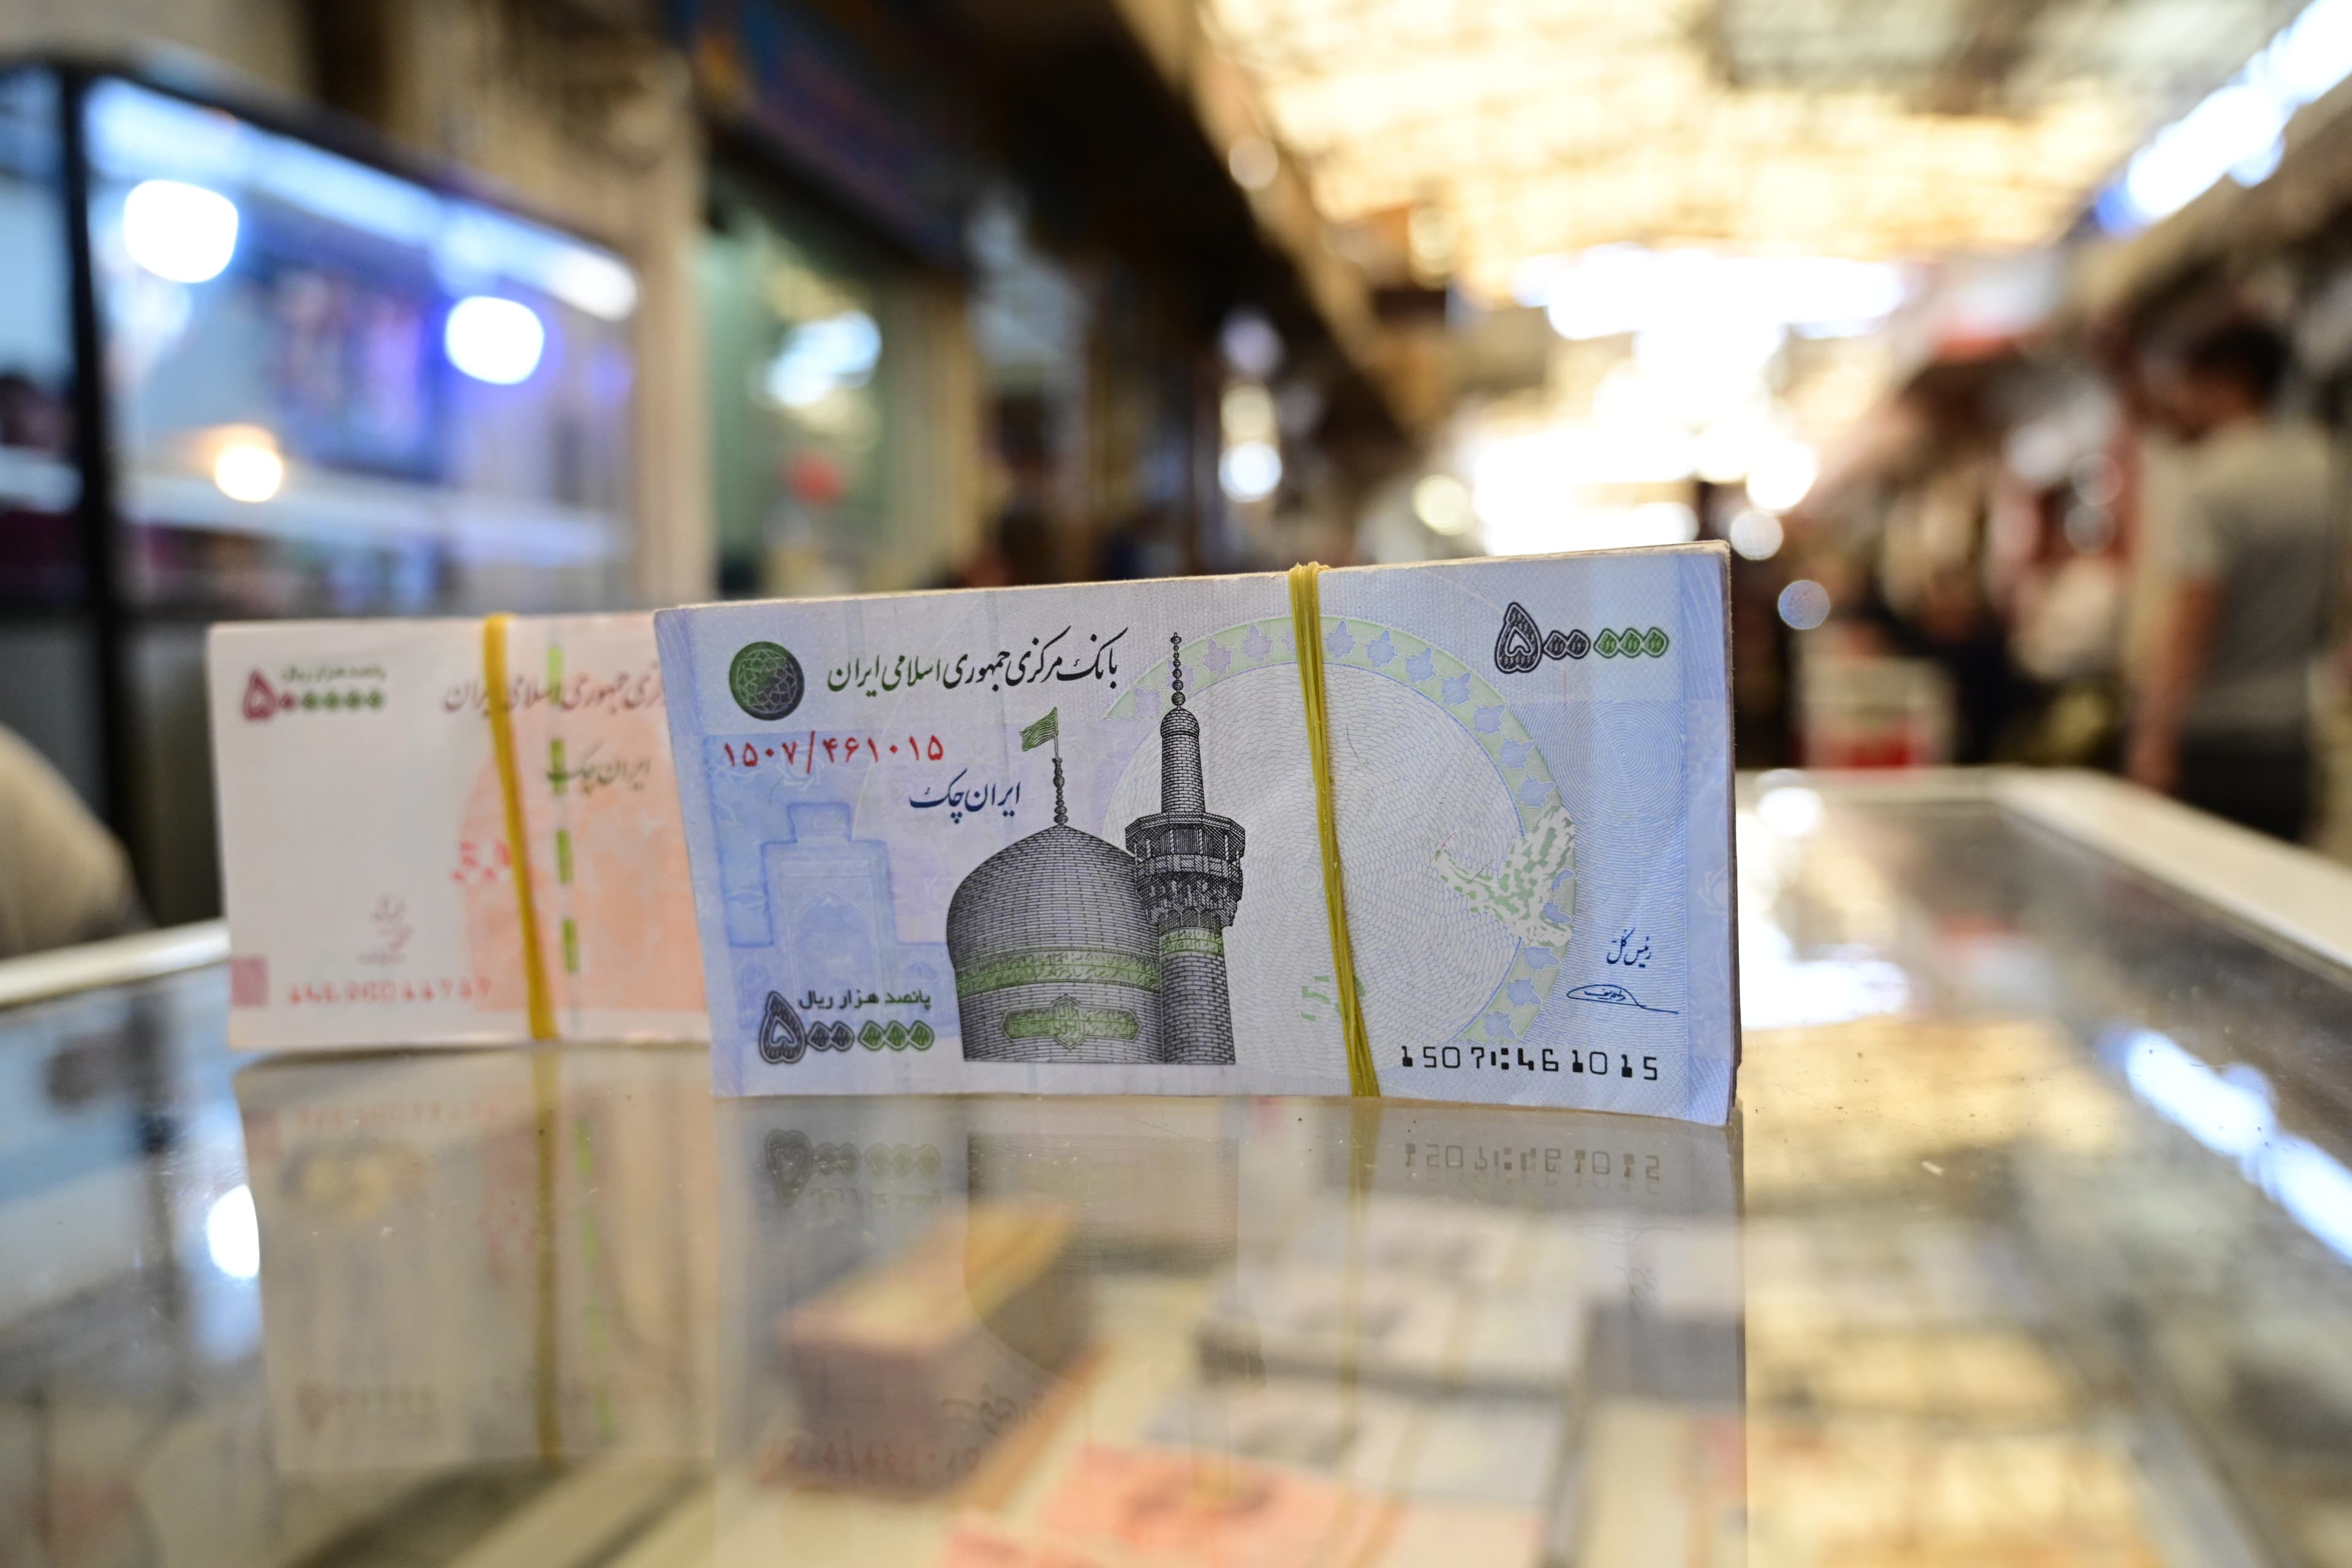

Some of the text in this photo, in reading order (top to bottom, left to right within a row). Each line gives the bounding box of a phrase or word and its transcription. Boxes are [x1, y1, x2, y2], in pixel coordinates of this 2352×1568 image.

[828, 625, 1128, 697] بانک مرکزی جمهوری اسلامی ایران
[910, 768, 1021, 824] ایران چک
[799, 989, 931, 1011] پانصد هزار ریال
